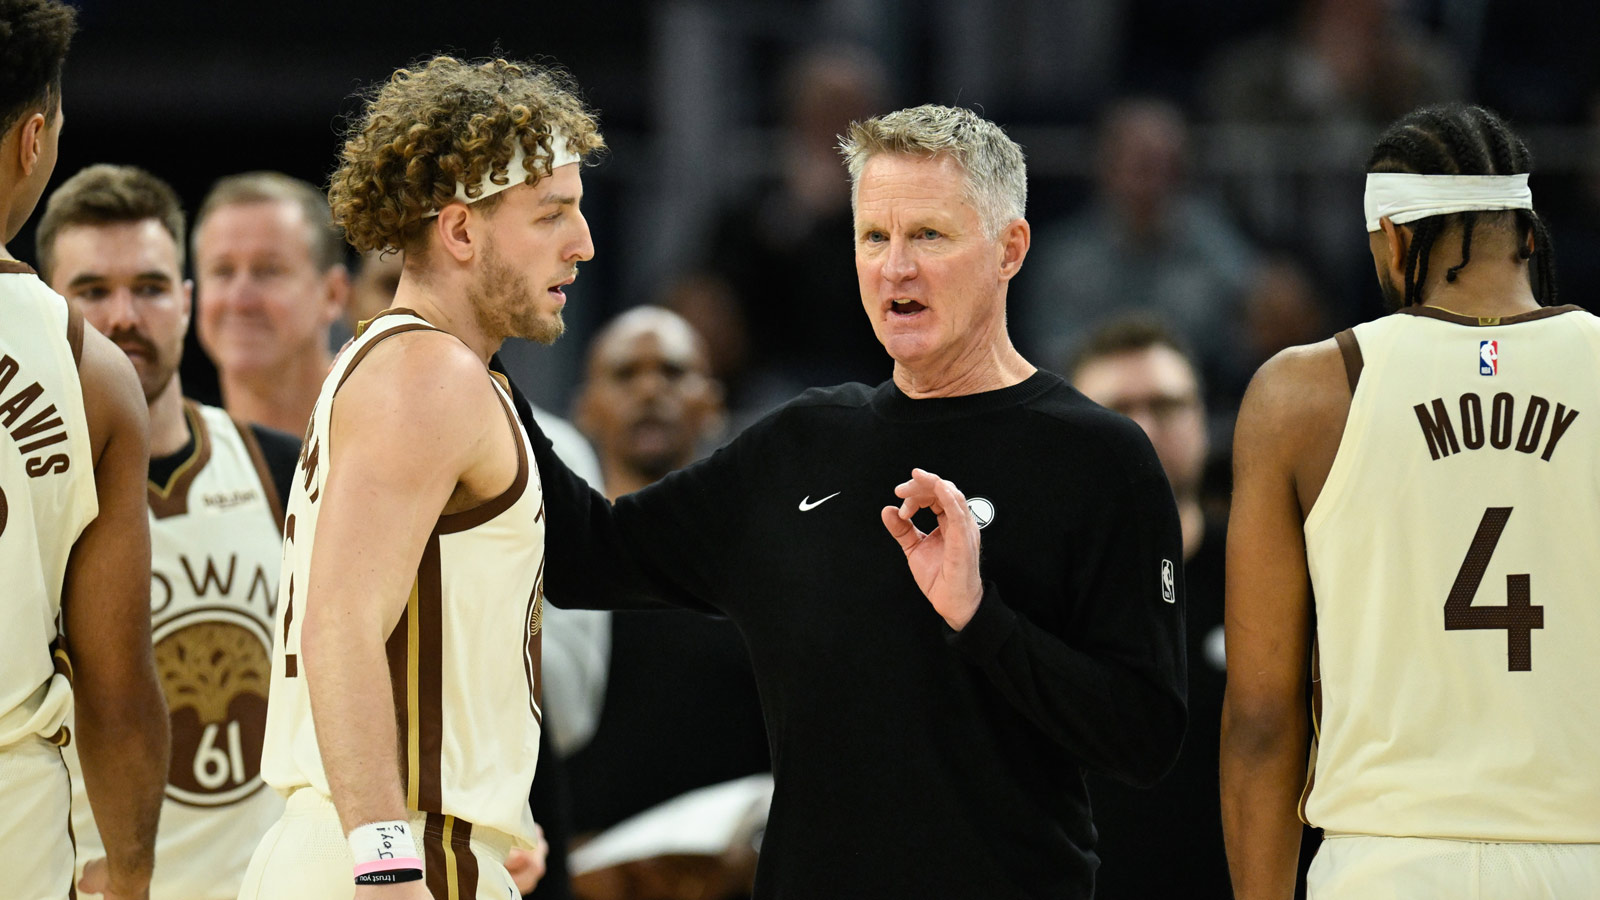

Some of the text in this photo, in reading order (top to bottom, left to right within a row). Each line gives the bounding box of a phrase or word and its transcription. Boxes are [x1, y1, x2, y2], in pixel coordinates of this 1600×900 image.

[1413, 392, 1580, 462] MOODY
[1443, 506, 1544, 672] 4
[193, 721, 245, 789] 61
[376, 827, 394, 860] Joy!
[359, 874, 372, 882] you
[373, 874, 391, 882] trust
